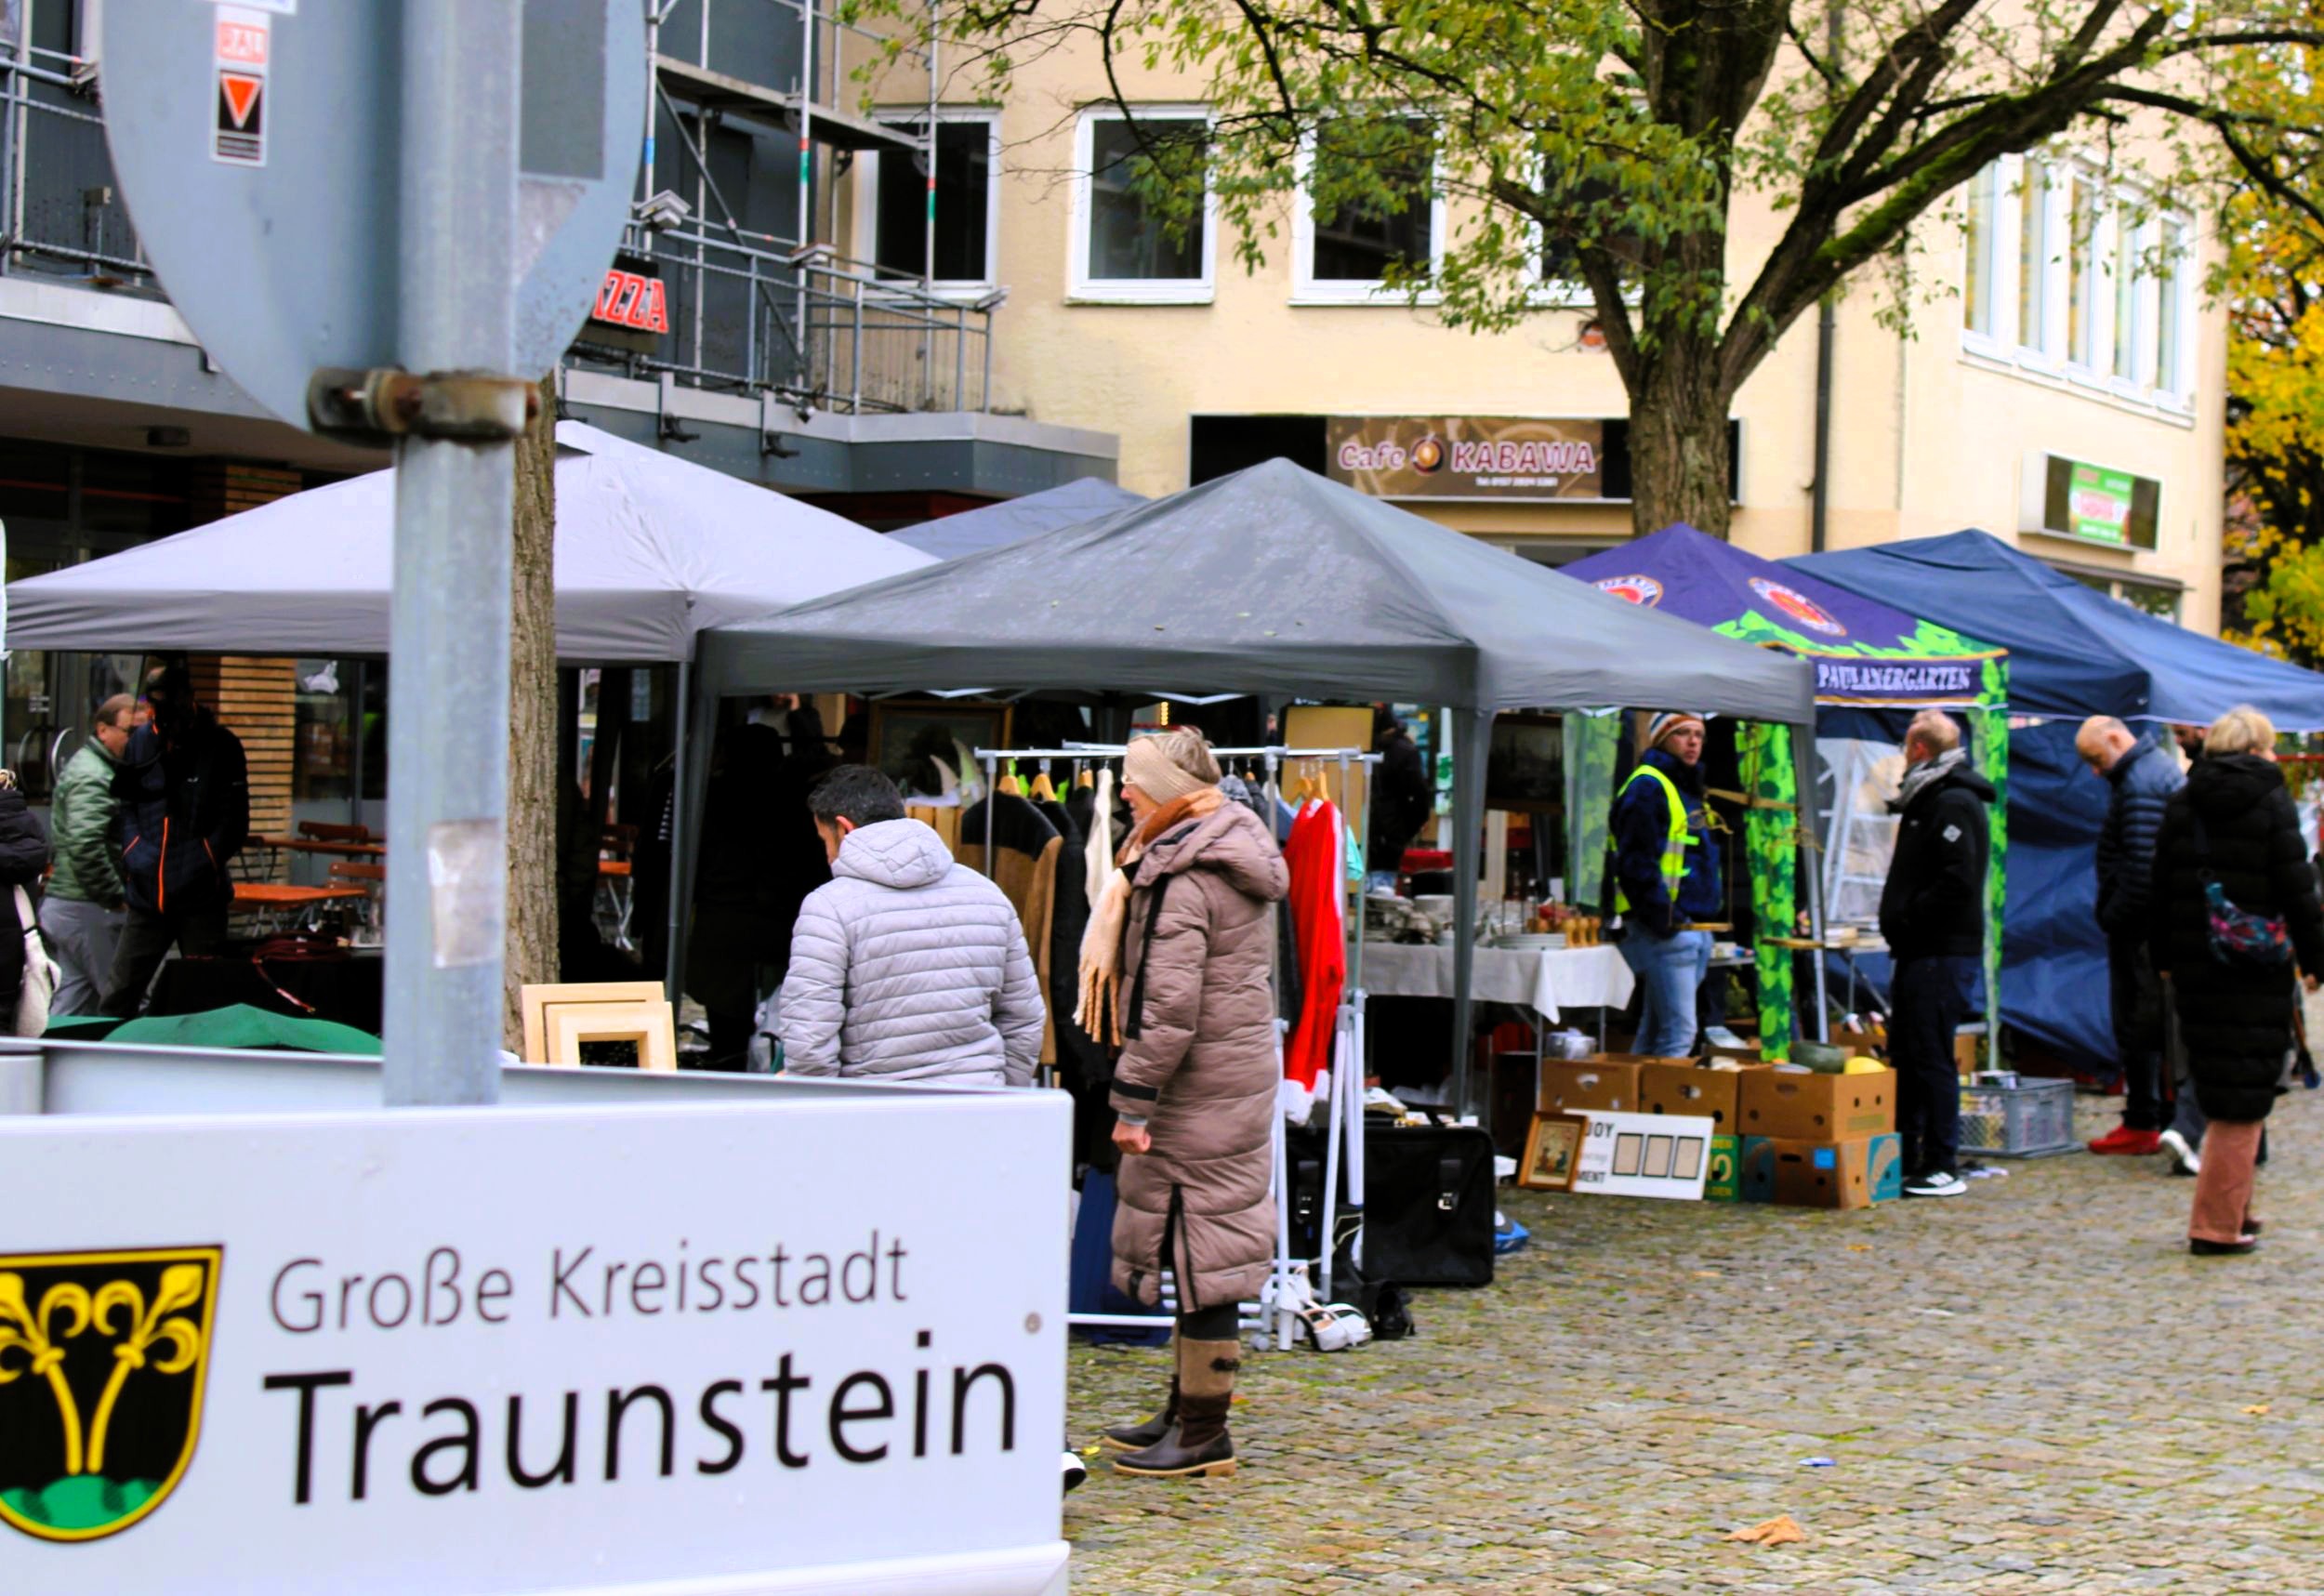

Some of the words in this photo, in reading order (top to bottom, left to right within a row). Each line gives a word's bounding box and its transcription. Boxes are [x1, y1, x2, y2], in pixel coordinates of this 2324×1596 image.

[592, 269, 669, 335] IZZA
[1338, 441, 1407, 471] Cafe
[1450, 441, 1596, 473] KABAWA
[1817, 663, 1973, 692] PAULANERGARTEN
[269, 1246, 513, 1335] Große
[550, 1230, 908, 1318] Kreisstadt
[261, 1327, 1017, 1507] Traunstein
